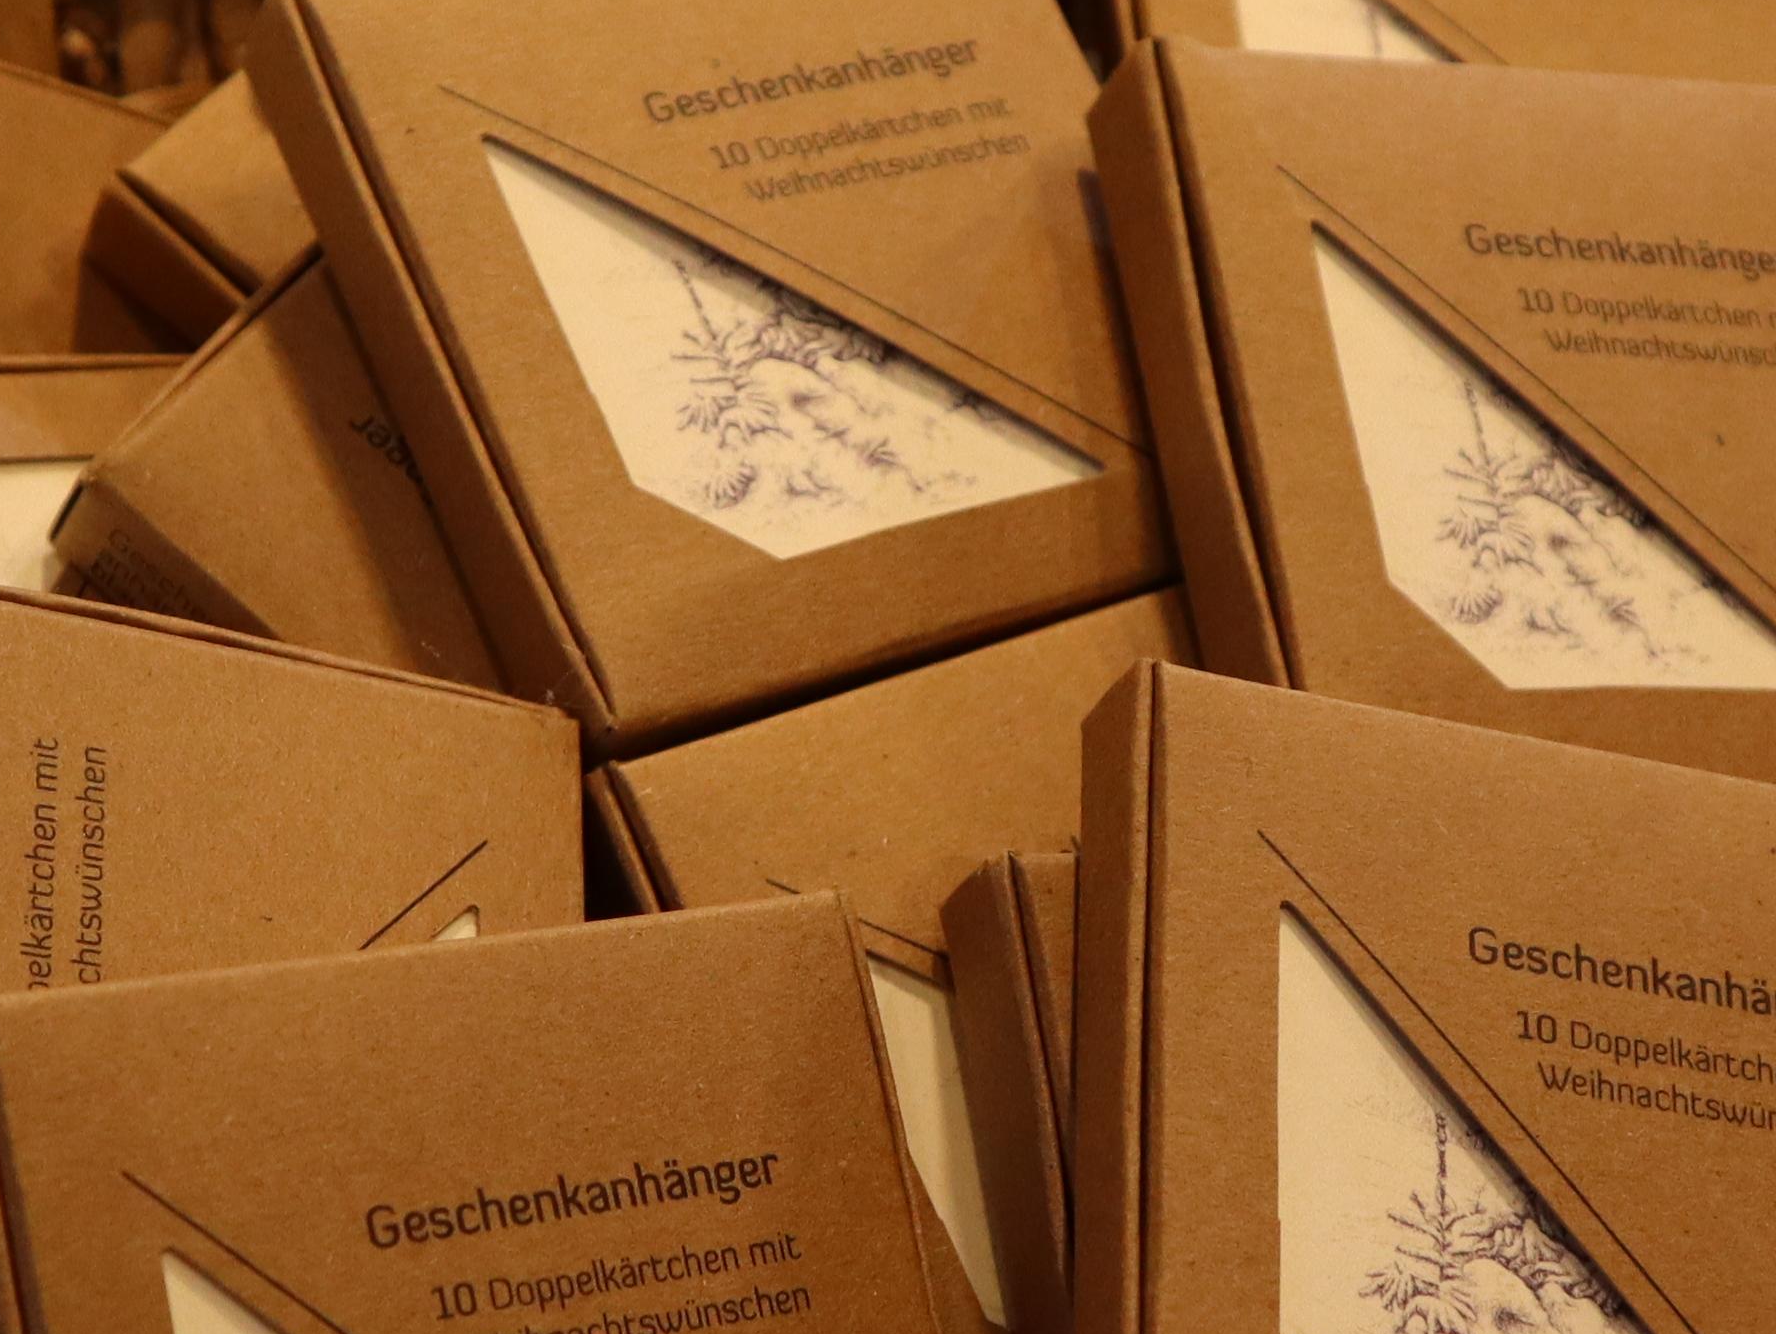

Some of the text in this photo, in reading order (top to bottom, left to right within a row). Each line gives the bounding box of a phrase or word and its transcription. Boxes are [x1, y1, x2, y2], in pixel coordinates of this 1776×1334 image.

[642, 39, 977, 123] Geschenkanhänger
[710, 141, 751, 169] 10
[1518, 287, 1555, 314] 10
[29, 737, 58, 792] mit
[70, 746, 107, 985] chtswünschen
[1516, 1010, 1557, 1045] 10
[365, 1152, 779, 1251] Geschenkanhänger
[430, 1231, 803, 1322] 10 Doppelkärtchen mit
